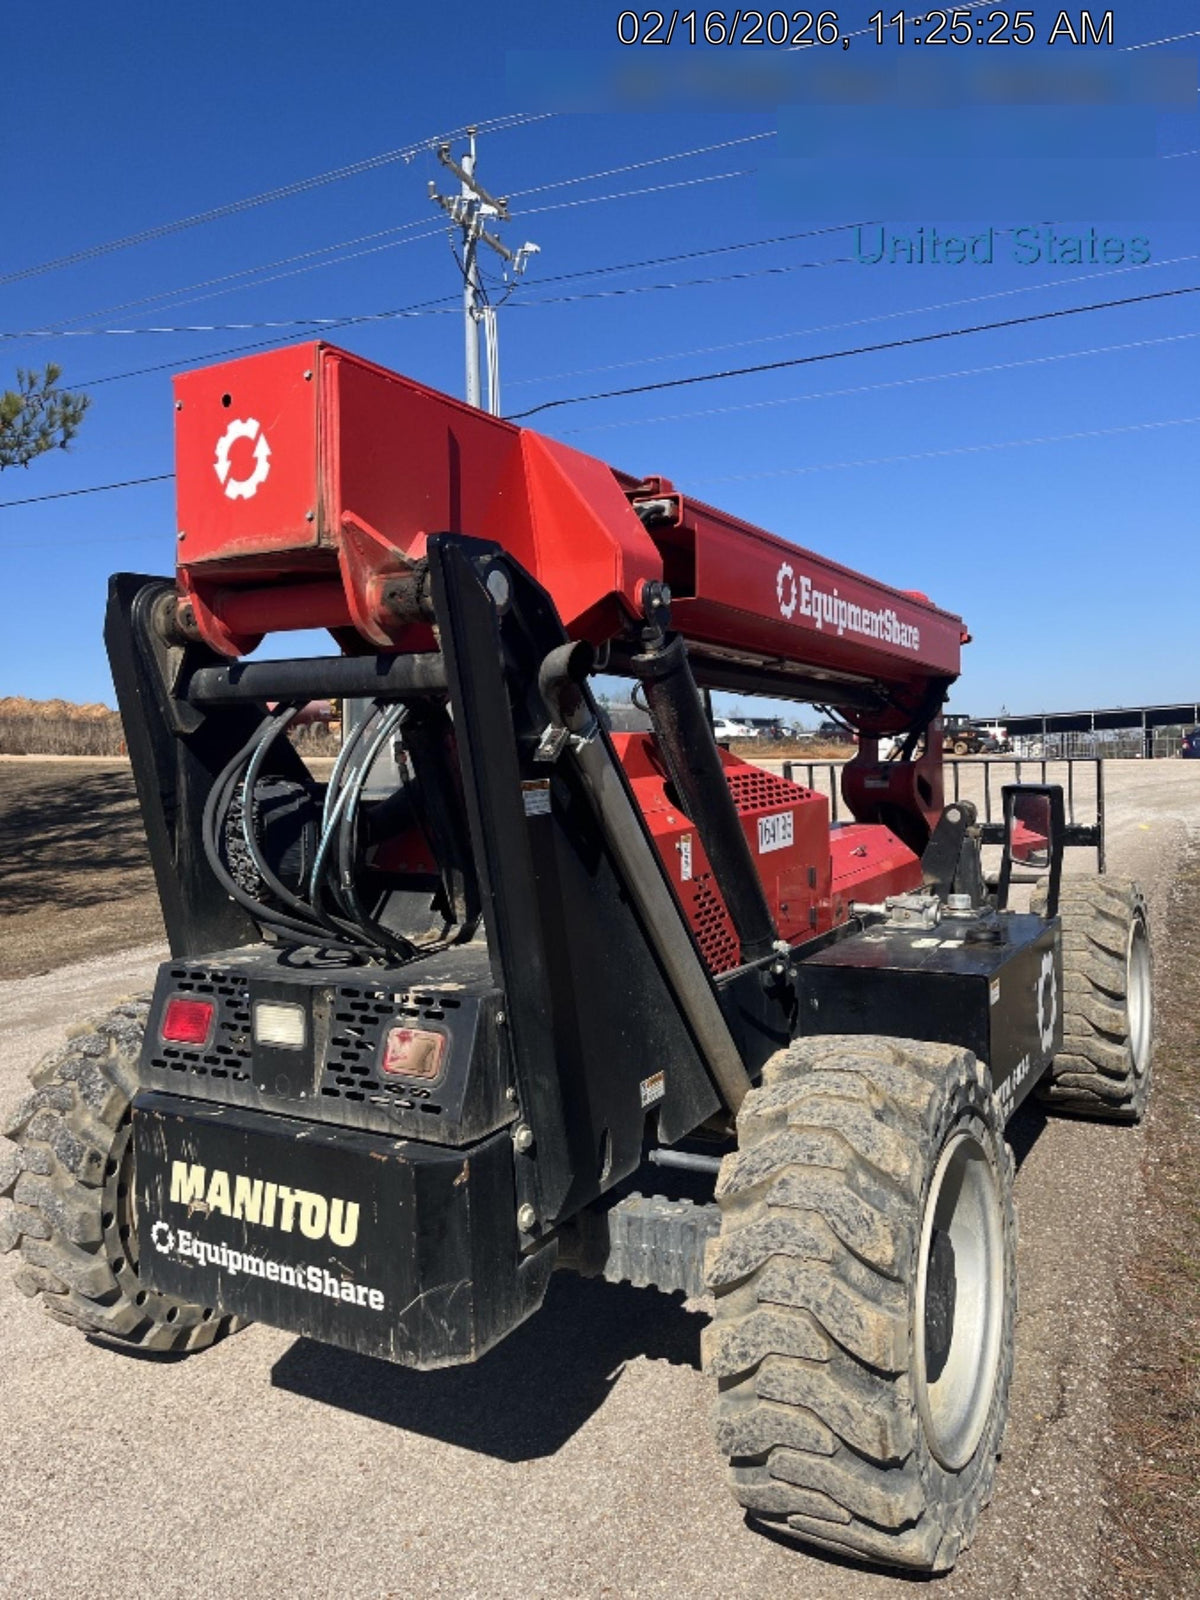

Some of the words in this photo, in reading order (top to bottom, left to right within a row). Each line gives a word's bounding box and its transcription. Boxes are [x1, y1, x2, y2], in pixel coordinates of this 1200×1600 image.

[800, 575, 920, 650] EquipmentShare
[169, 1160, 360, 1247] MANITOU
[177, 1229, 385, 1311] EquipmentShare
